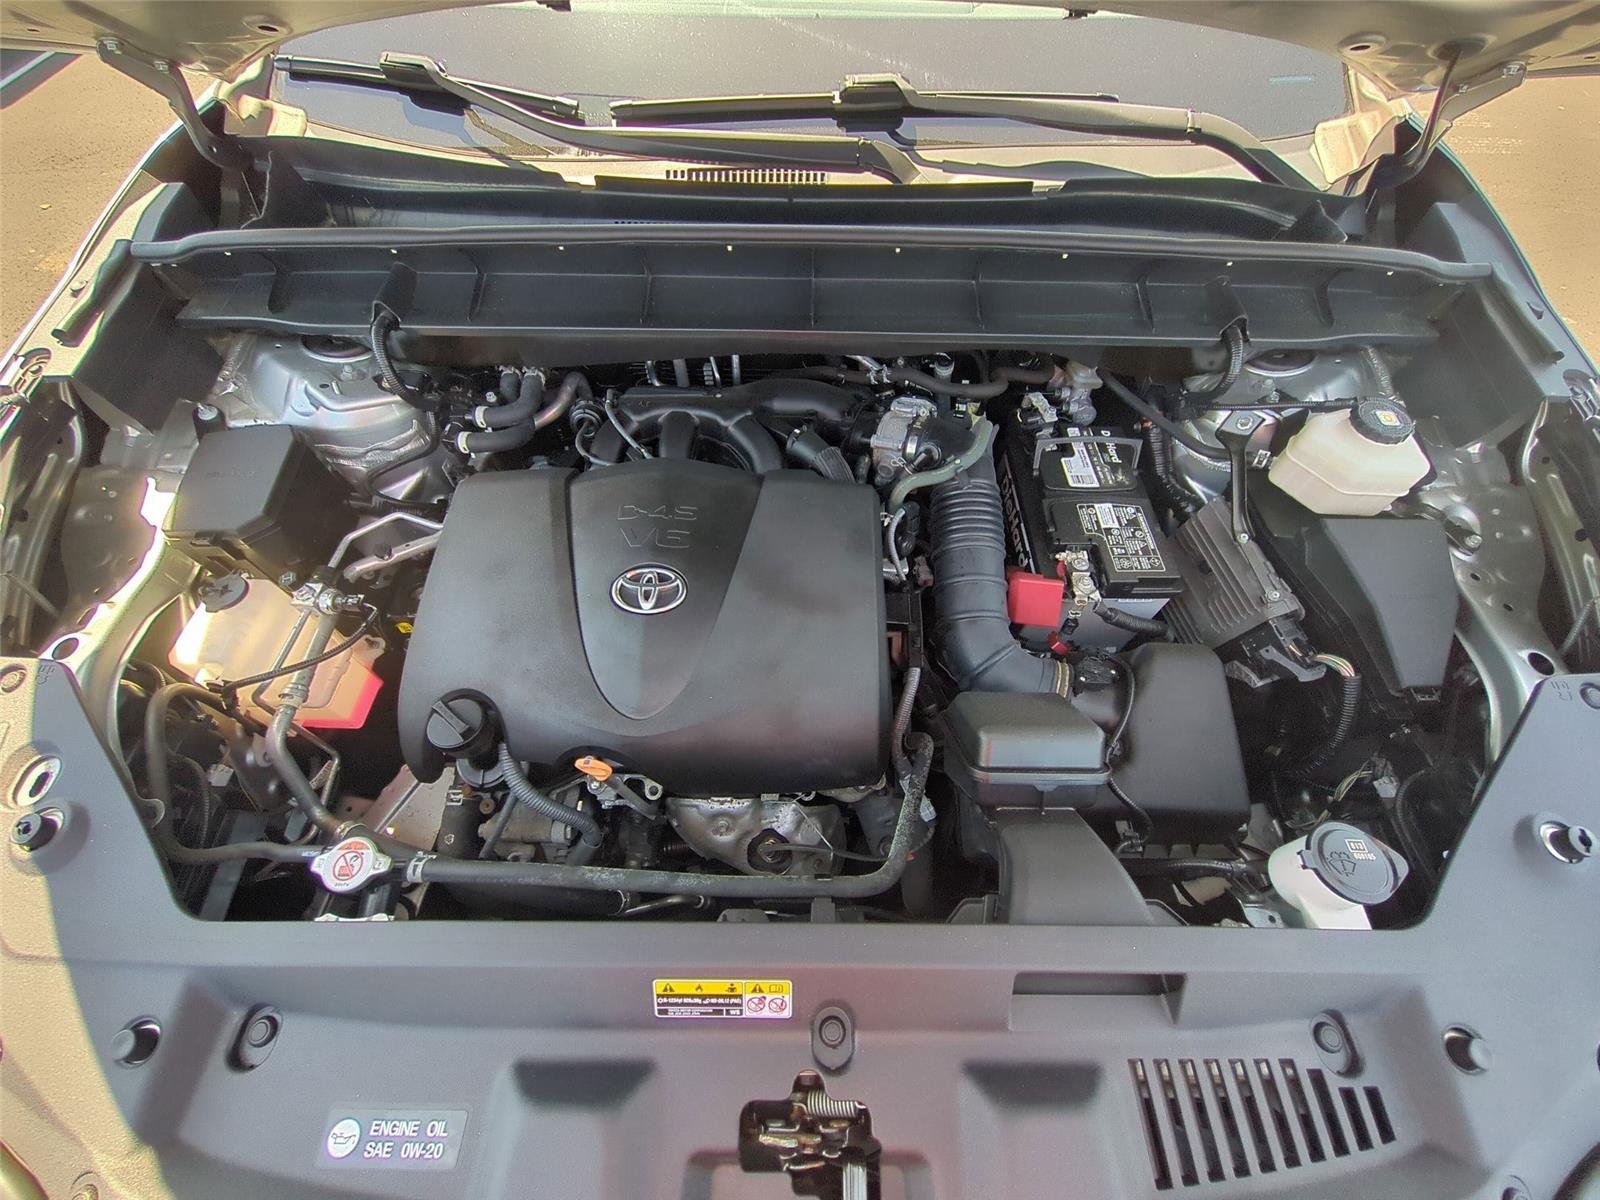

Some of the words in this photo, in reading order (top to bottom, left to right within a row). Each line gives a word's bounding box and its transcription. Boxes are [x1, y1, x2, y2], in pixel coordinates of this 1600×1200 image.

[1101, 430, 1122, 464] DHard
[368, 1119, 420, 1137] ENGINE
[426, 1120, 449, 1137] OIL
[363, 1141, 394, 1159] SAE
[400, 1142, 444, 1160] 0W-20
